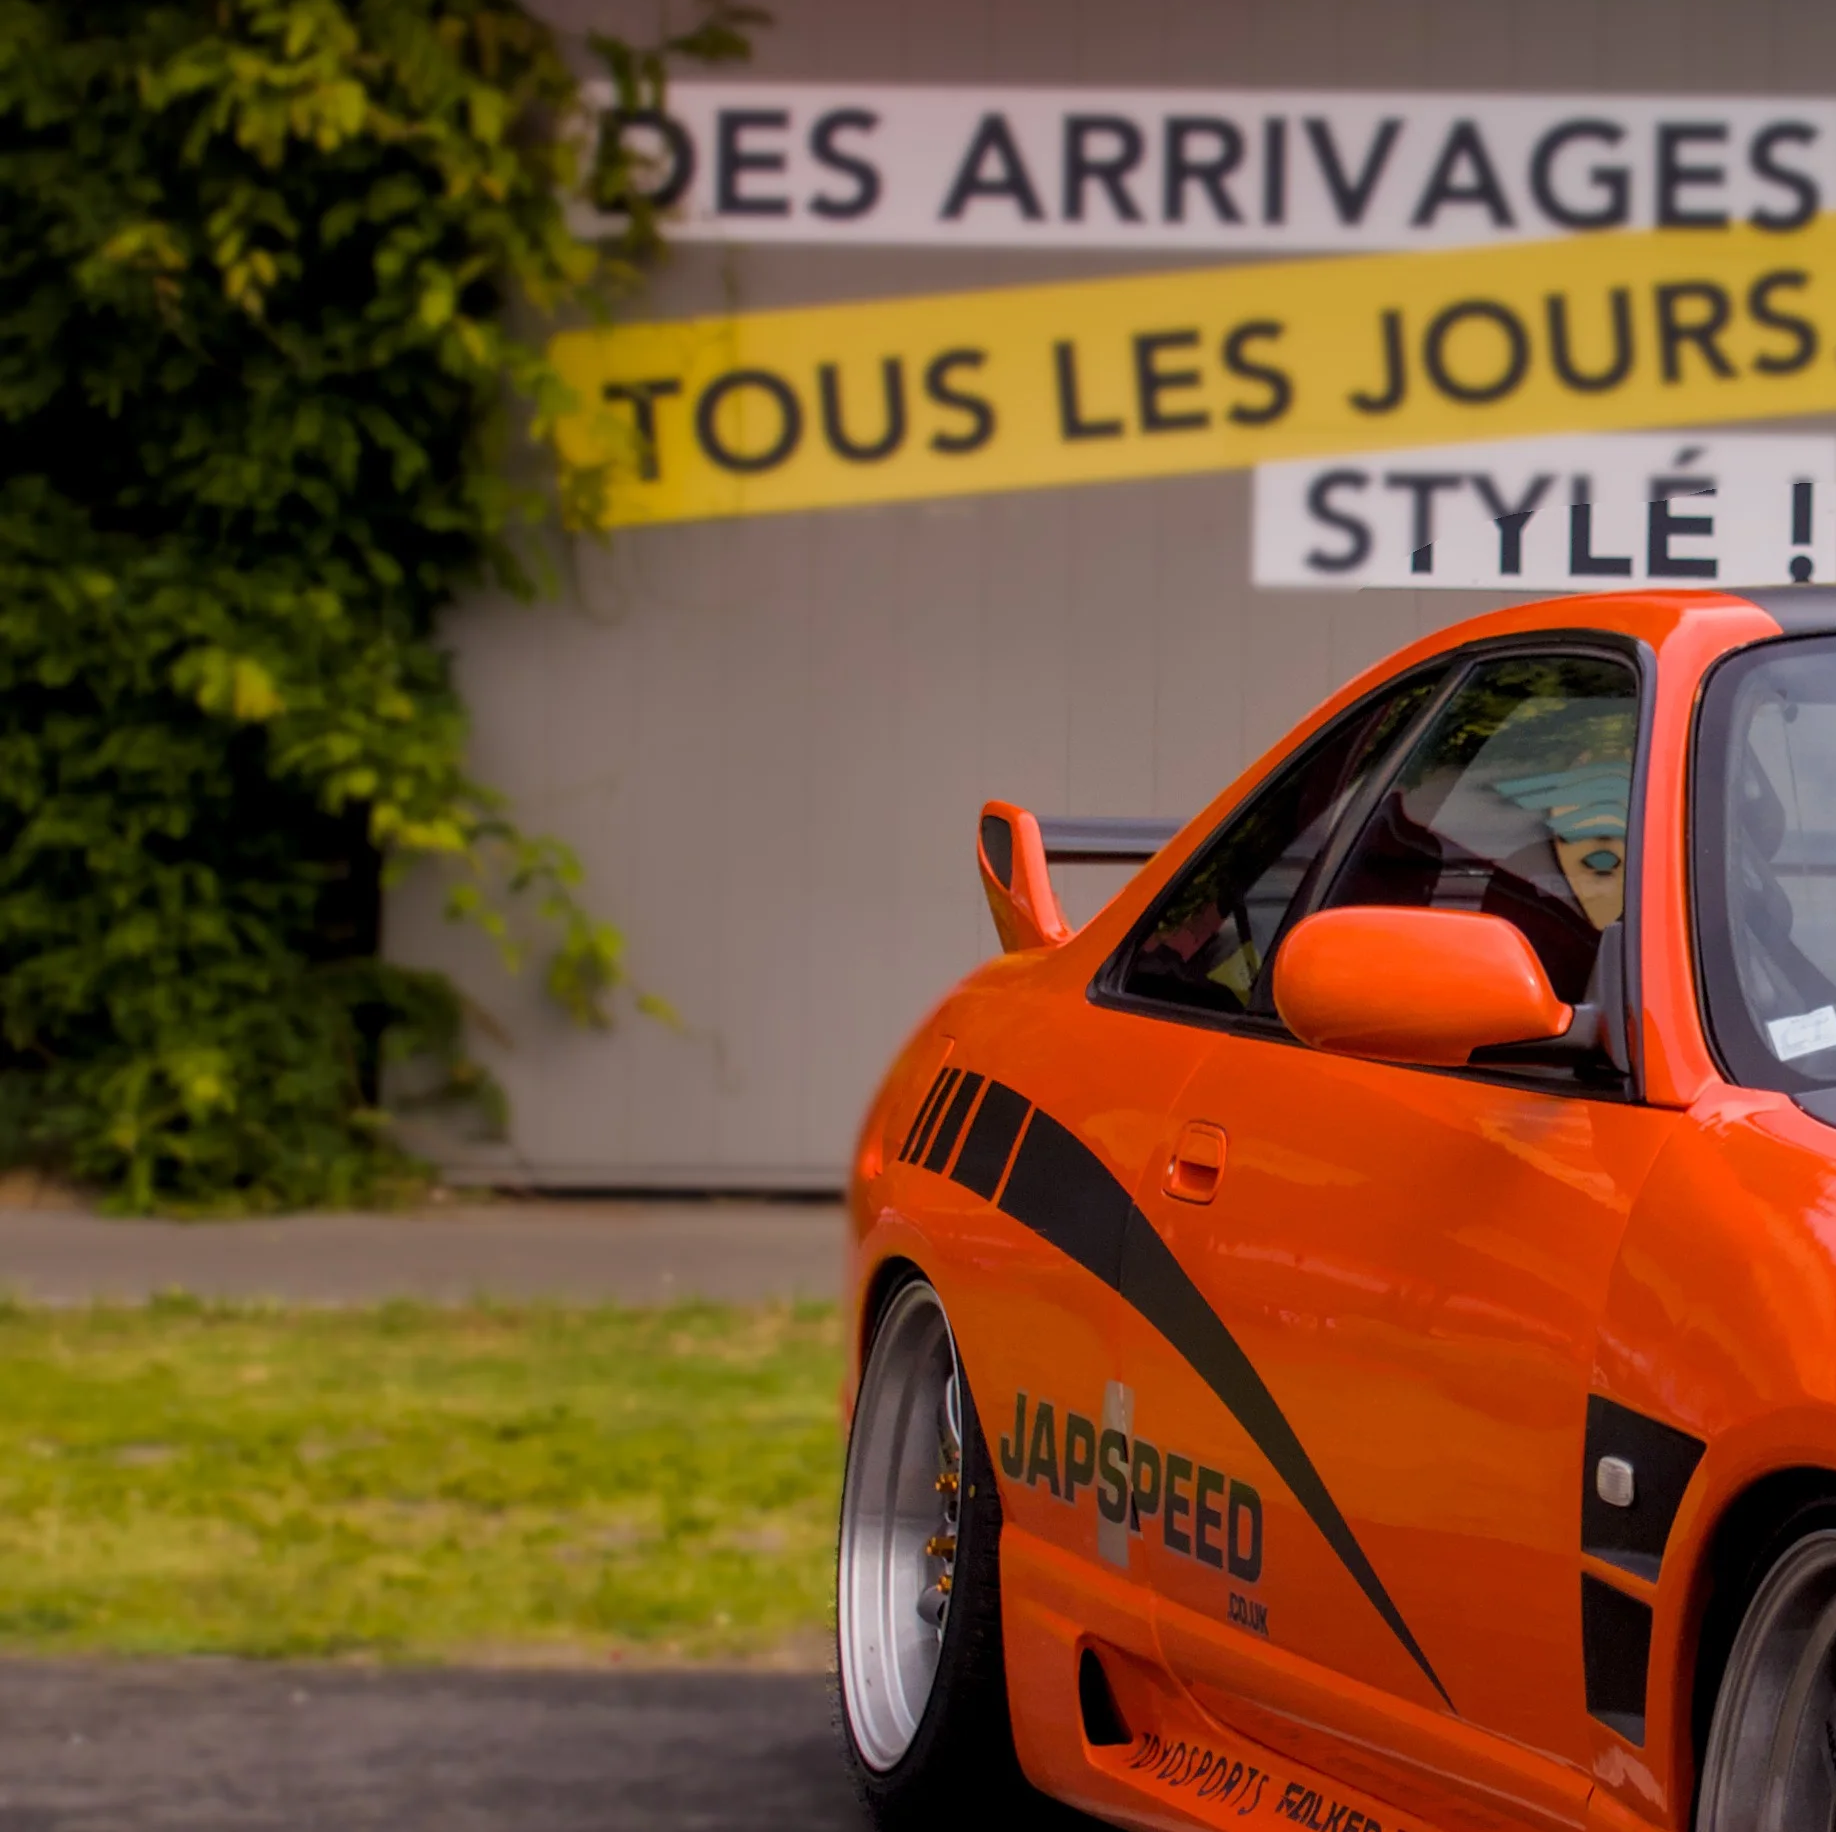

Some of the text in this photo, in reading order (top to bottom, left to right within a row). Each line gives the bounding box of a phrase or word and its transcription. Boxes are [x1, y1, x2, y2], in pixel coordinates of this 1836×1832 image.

[598, 105, 1818, 235] DES ARRIVAGES
[603, 348, 995, 482] TOUS
[1053, 320, 1293, 443] LES
[1304, 447, 1814, 583] STYLÉ !
[1000, 1392, 1263, 1583] JAPSPEED
